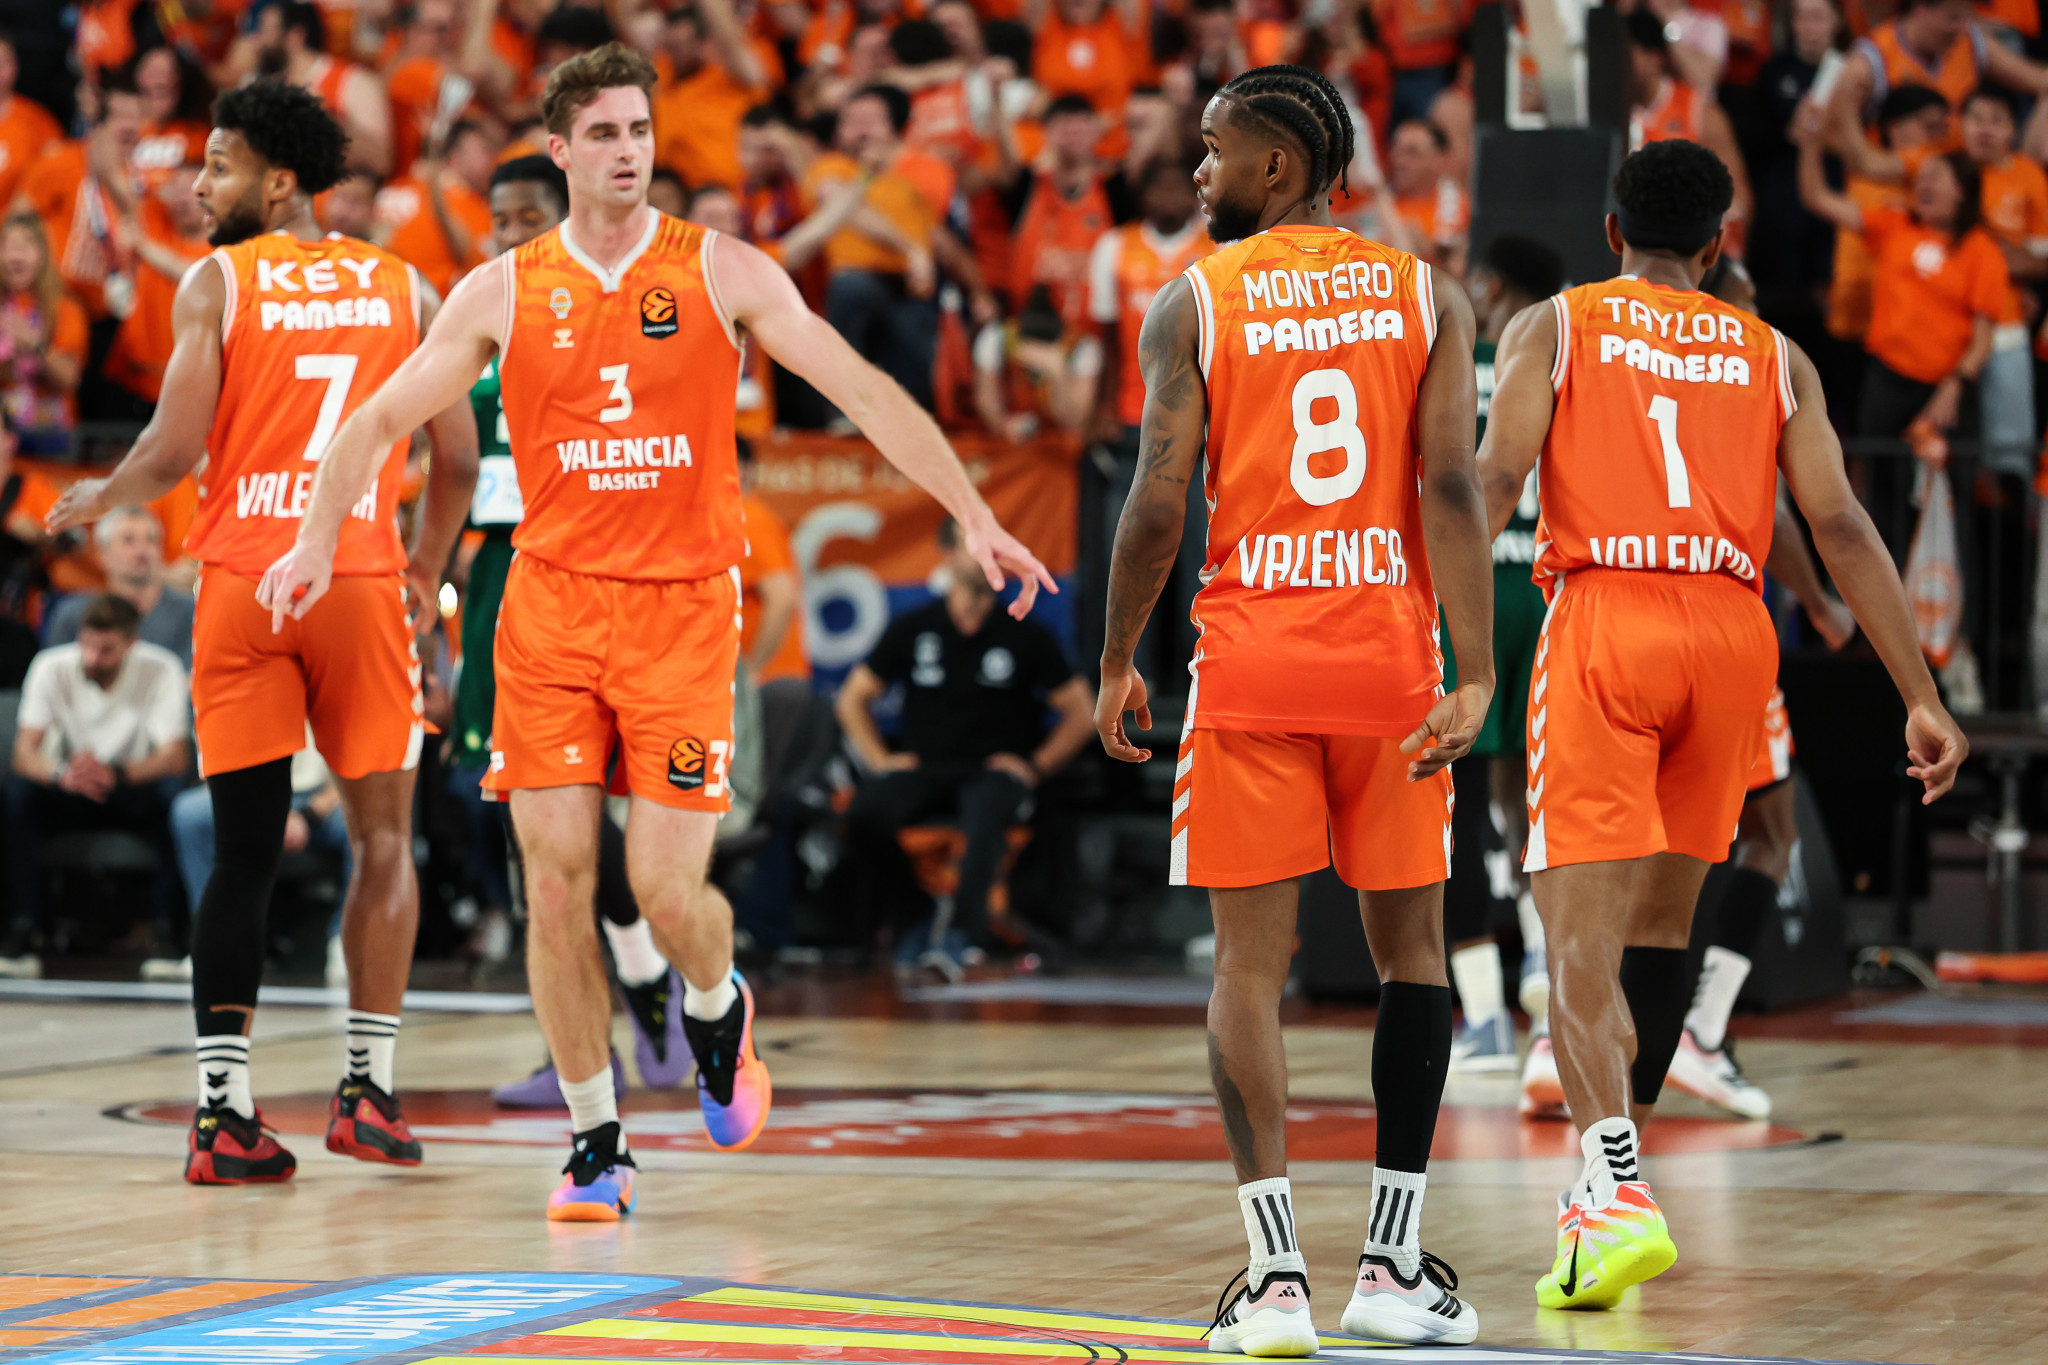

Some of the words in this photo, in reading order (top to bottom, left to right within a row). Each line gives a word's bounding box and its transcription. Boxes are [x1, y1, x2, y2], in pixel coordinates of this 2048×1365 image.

[257, 257, 380, 294] KEY
[1242, 260, 1393, 312] MONTERO
[260, 296, 392, 331] PAMESA
[1243, 308, 1404, 355] PAMESA
[1602, 296, 1745, 347] TAYLOR
[1600, 334, 1750, 386] PAMESA
[295, 353, 359, 462] 7
[599, 362, 634, 424] 3
[556, 433, 693, 475] VALENCIA
[1289, 367, 1368, 507] 8
[1647, 393, 1692, 509] 1
[236, 470, 379, 522] VALEA
[588, 470, 661, 492] BASKET
[790, 502, 888, 668] 6
[704, 739, 728, 798] 3
[200, 1278, 628, 1340] BASKET
